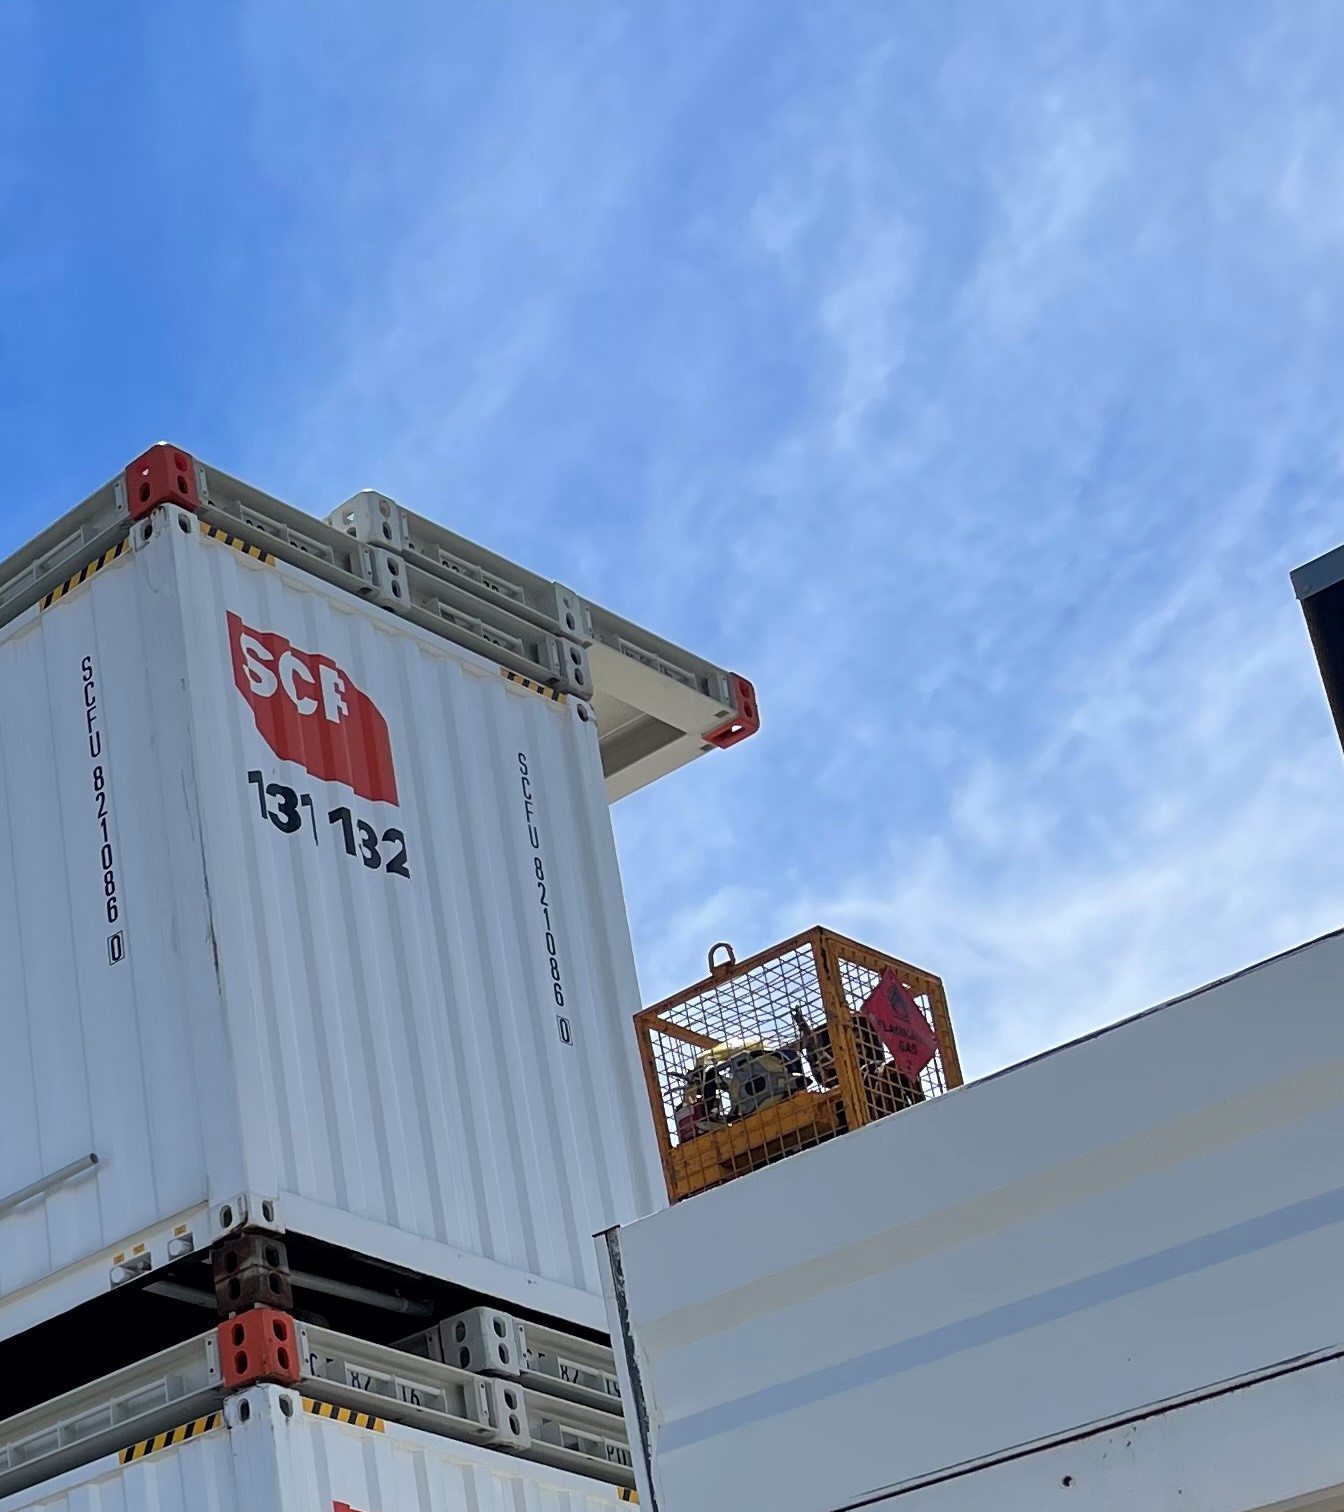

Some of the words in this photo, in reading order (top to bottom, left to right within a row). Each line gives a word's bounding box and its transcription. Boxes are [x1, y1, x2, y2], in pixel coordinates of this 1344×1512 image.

[240, 632, 349, 724] SCF
[82, 656, 101, 757] SCFU
[93, 765, 118, 923] 821086
[248, 770, 319, 846] 131
[328, 806, 410, 879] 132
[518, 752, 540, 849] SCFU
[534, 857, 564, 1006] 821086
